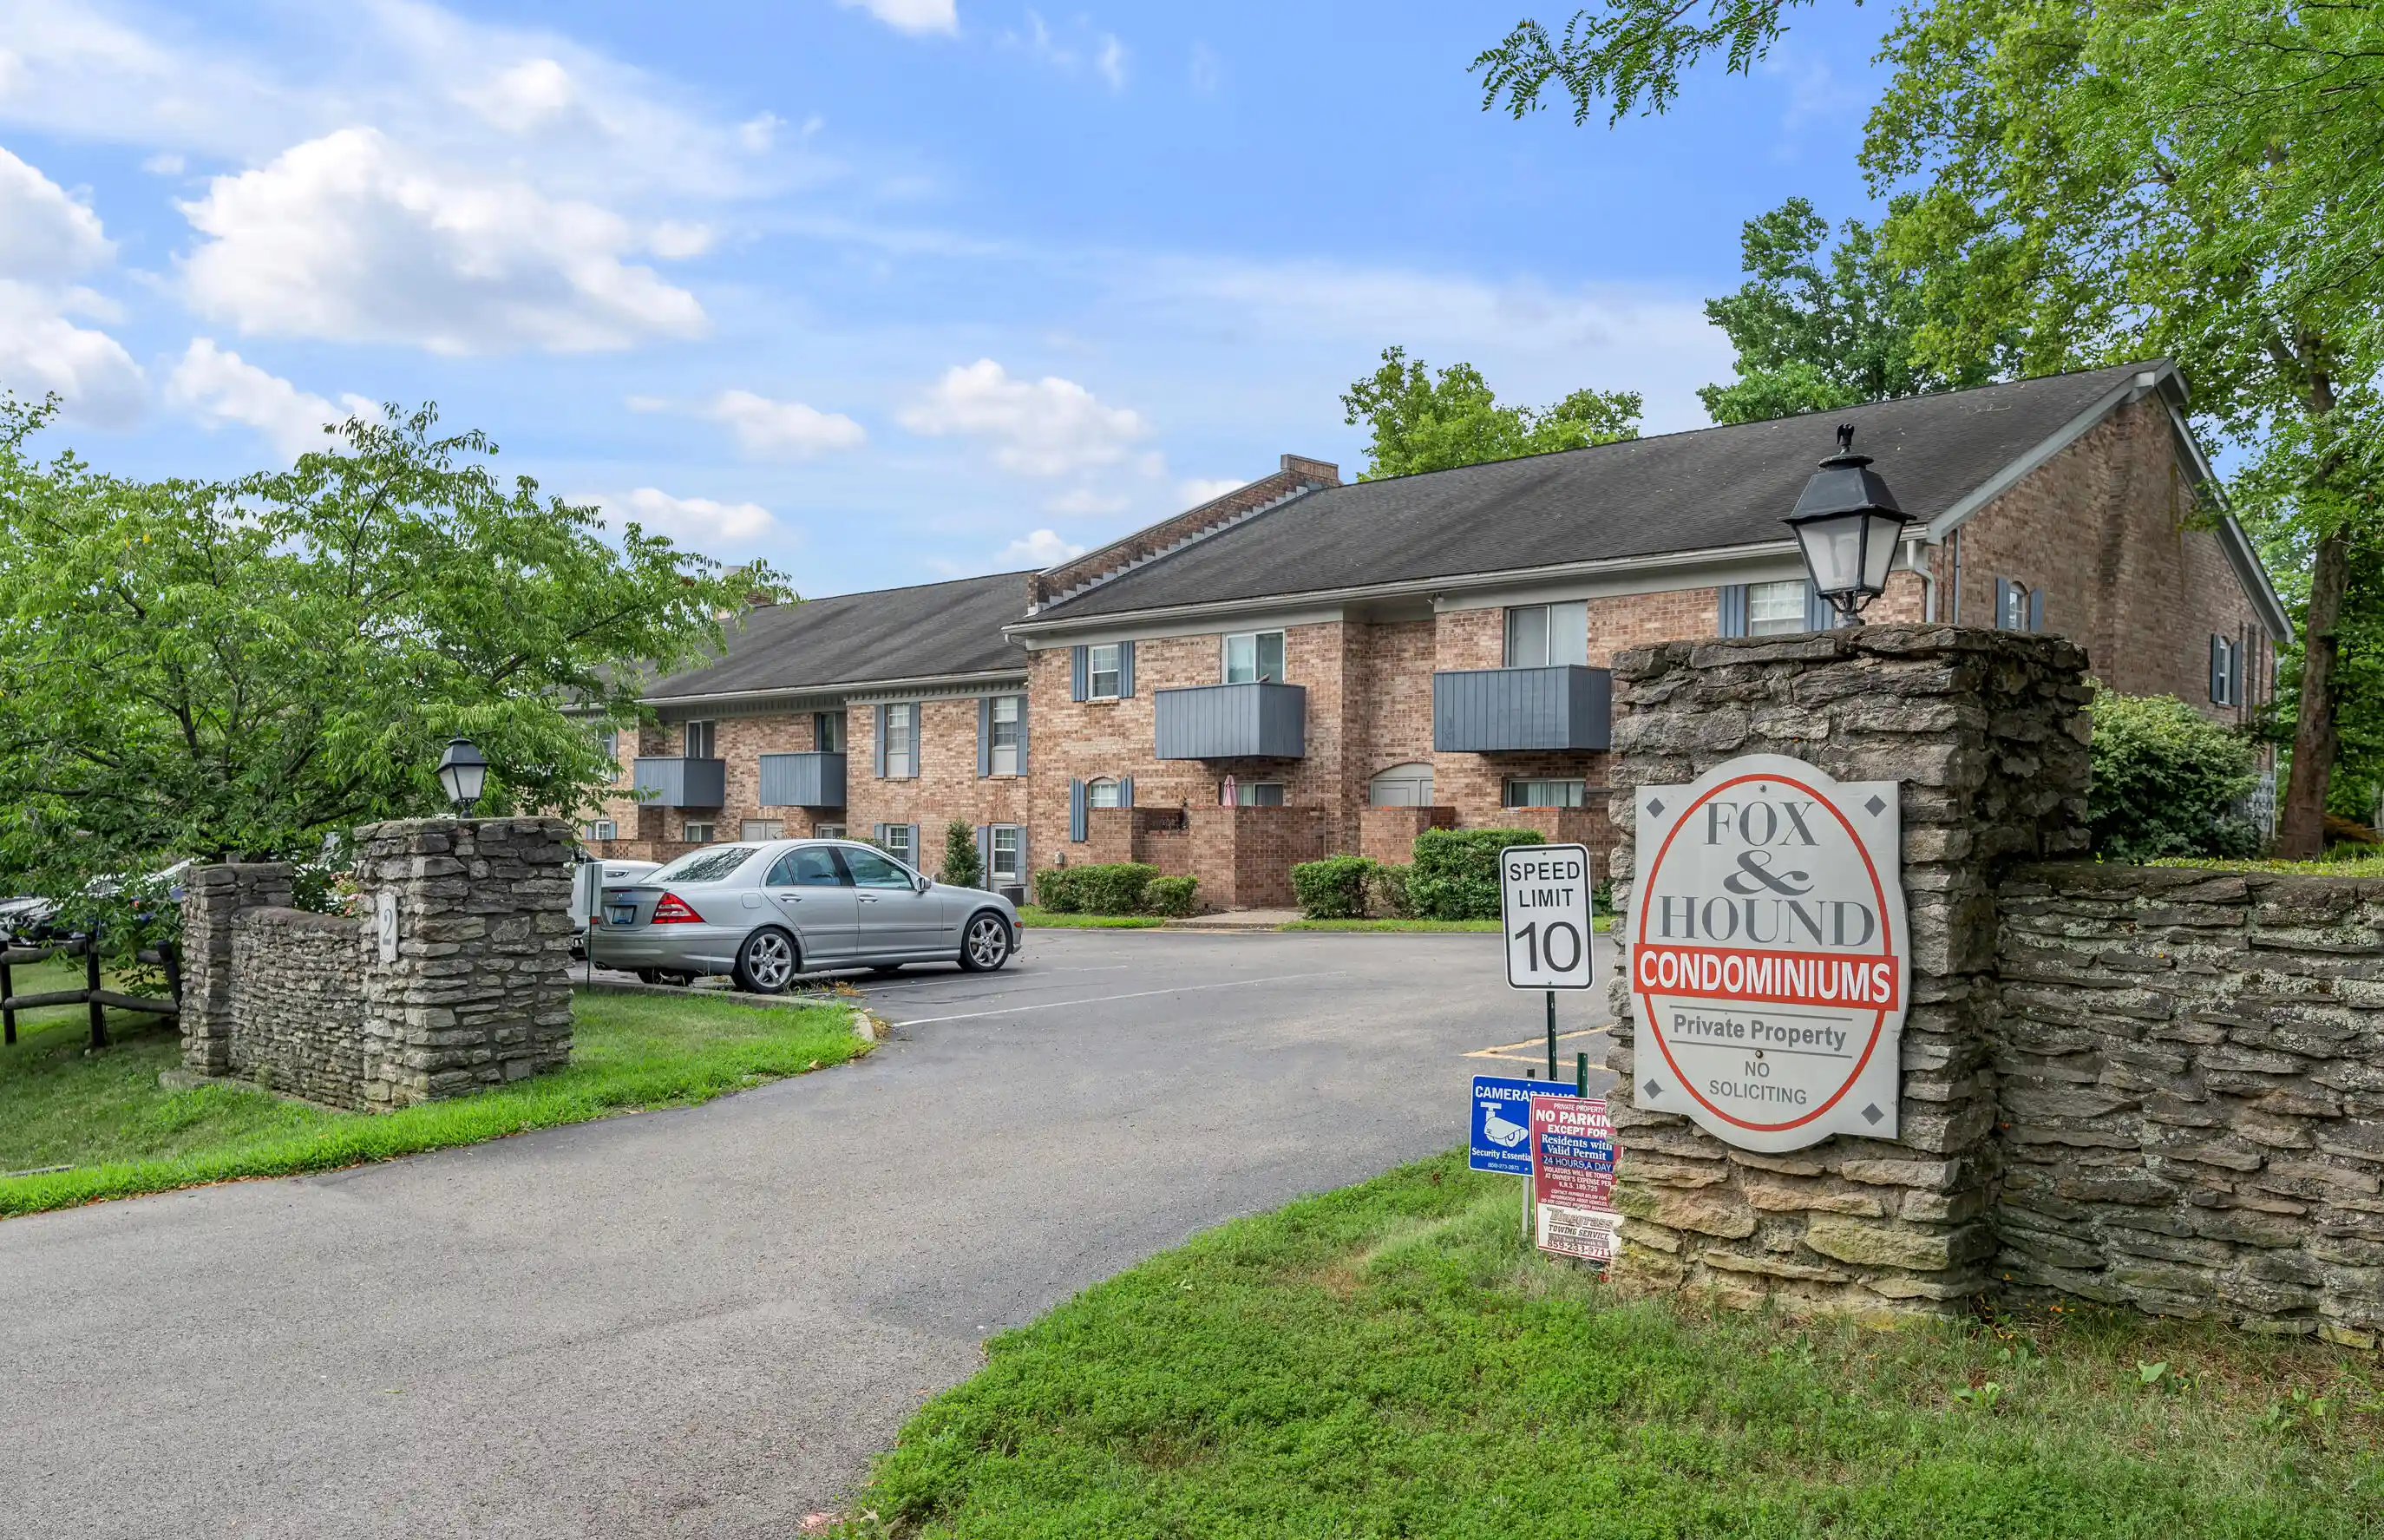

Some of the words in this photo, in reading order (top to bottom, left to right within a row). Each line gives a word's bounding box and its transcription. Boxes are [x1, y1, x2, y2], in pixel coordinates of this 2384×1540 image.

[1703, 801, 1820, 847] FOX
[1510, 861, 1581, 881] SPEED
[1723, 849, 1814, 896] &
[1518, 888, 1574, 908] LIMIT
[383, 908, 393, 946] 2
[1658, 895, 1875, 947] HOUND
[1515, 921, 1582, 973] 10
[1639, 950, 1891, 1004] CONDOMINIUMS
[1673, 1013, 1745, 1039] Private
[1751, 1019, 1847, 1052] Property
[1745, 1060, 1770, 1078] NO
[1709, 1079, 1807, 1105] SOLICITING
[1576, 1104, 1604, 1113] PROPERTY
[1536, 1109, 1555, 1122] NO
[1559, 1111, 1611, 1128] PARKIN
[1548, 1124, 1585, 1136] EXCEPT
[1588, 1128, 1608, 1137] FOR
[1541, 1133, 1588, 1148] Residents
[1590, 1140, 1613, 1150] with
[1471, 1147, 1500, 1159] Security
[1502, 1150, 1531, 1162] Essentia
[1547, 1144, 1570, 1156] Valid
[1573, 1147, 1607, 1161] Permit
[1543, 1156, 1553, 1164] 24
[1555, 1157, 1584, 1168] HOURS
[1595, 1163, 1612, 1171] DAY
[1543, 1166, 1571, 1176] VIOLATORS
[1552, 1174, 1576, 1183] OWNER'S
[1576, 1176, 1601, 1186] EXPENSE
[1549, 1224, 1577, 1235] TOWING
[1578, 1229, 1610, 1240] SERVICE
